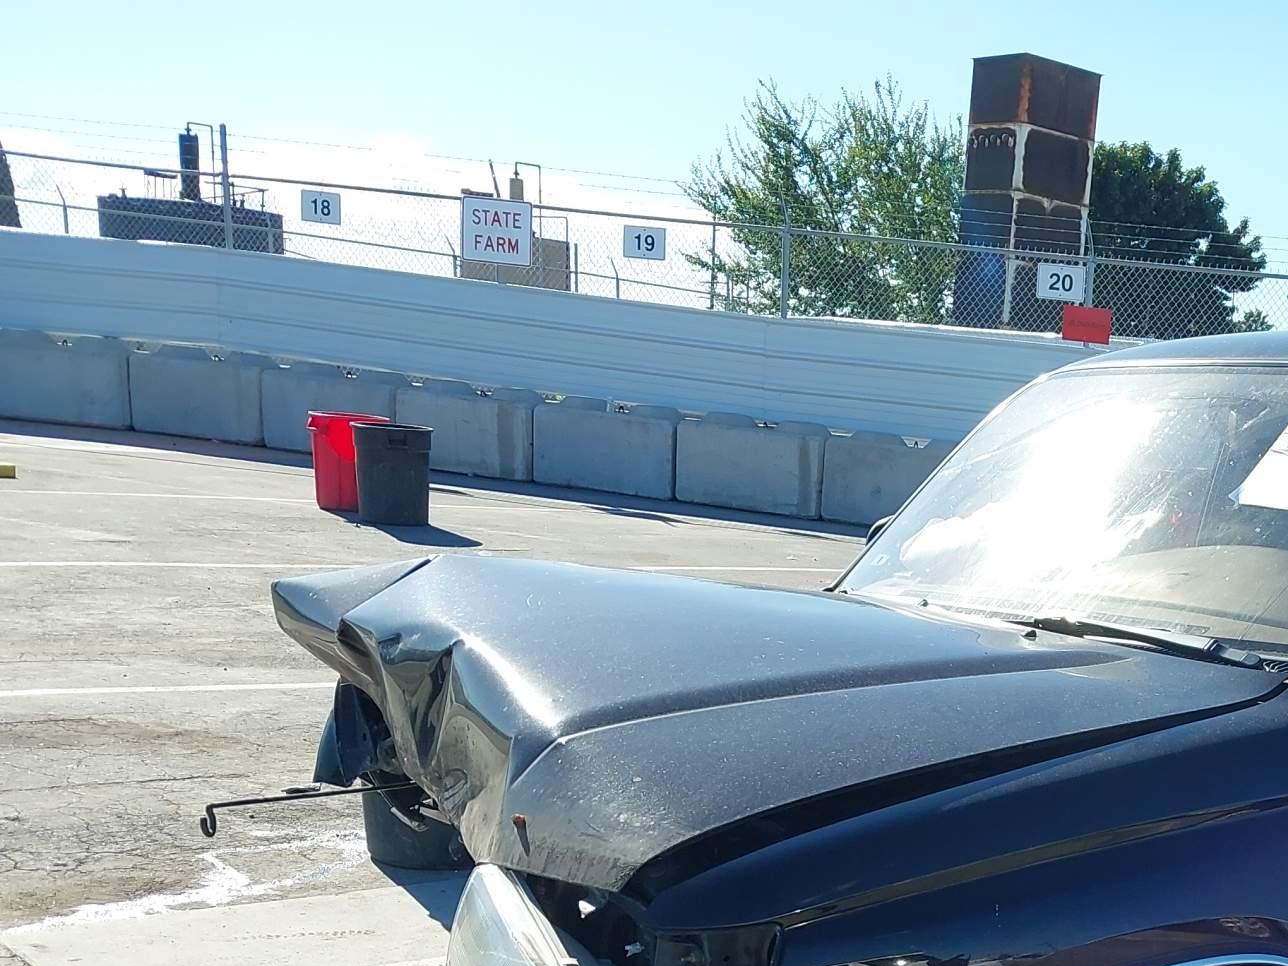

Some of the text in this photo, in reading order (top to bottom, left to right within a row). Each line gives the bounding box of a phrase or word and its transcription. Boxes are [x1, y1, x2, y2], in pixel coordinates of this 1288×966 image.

[311, 198, 331, 217] 18
[472, 208, 522, 229] STATE
[474, 234, 519, 255] FARM
[634, 233, 655, 252] 19
[1049, 273, 1074, 292] 20
